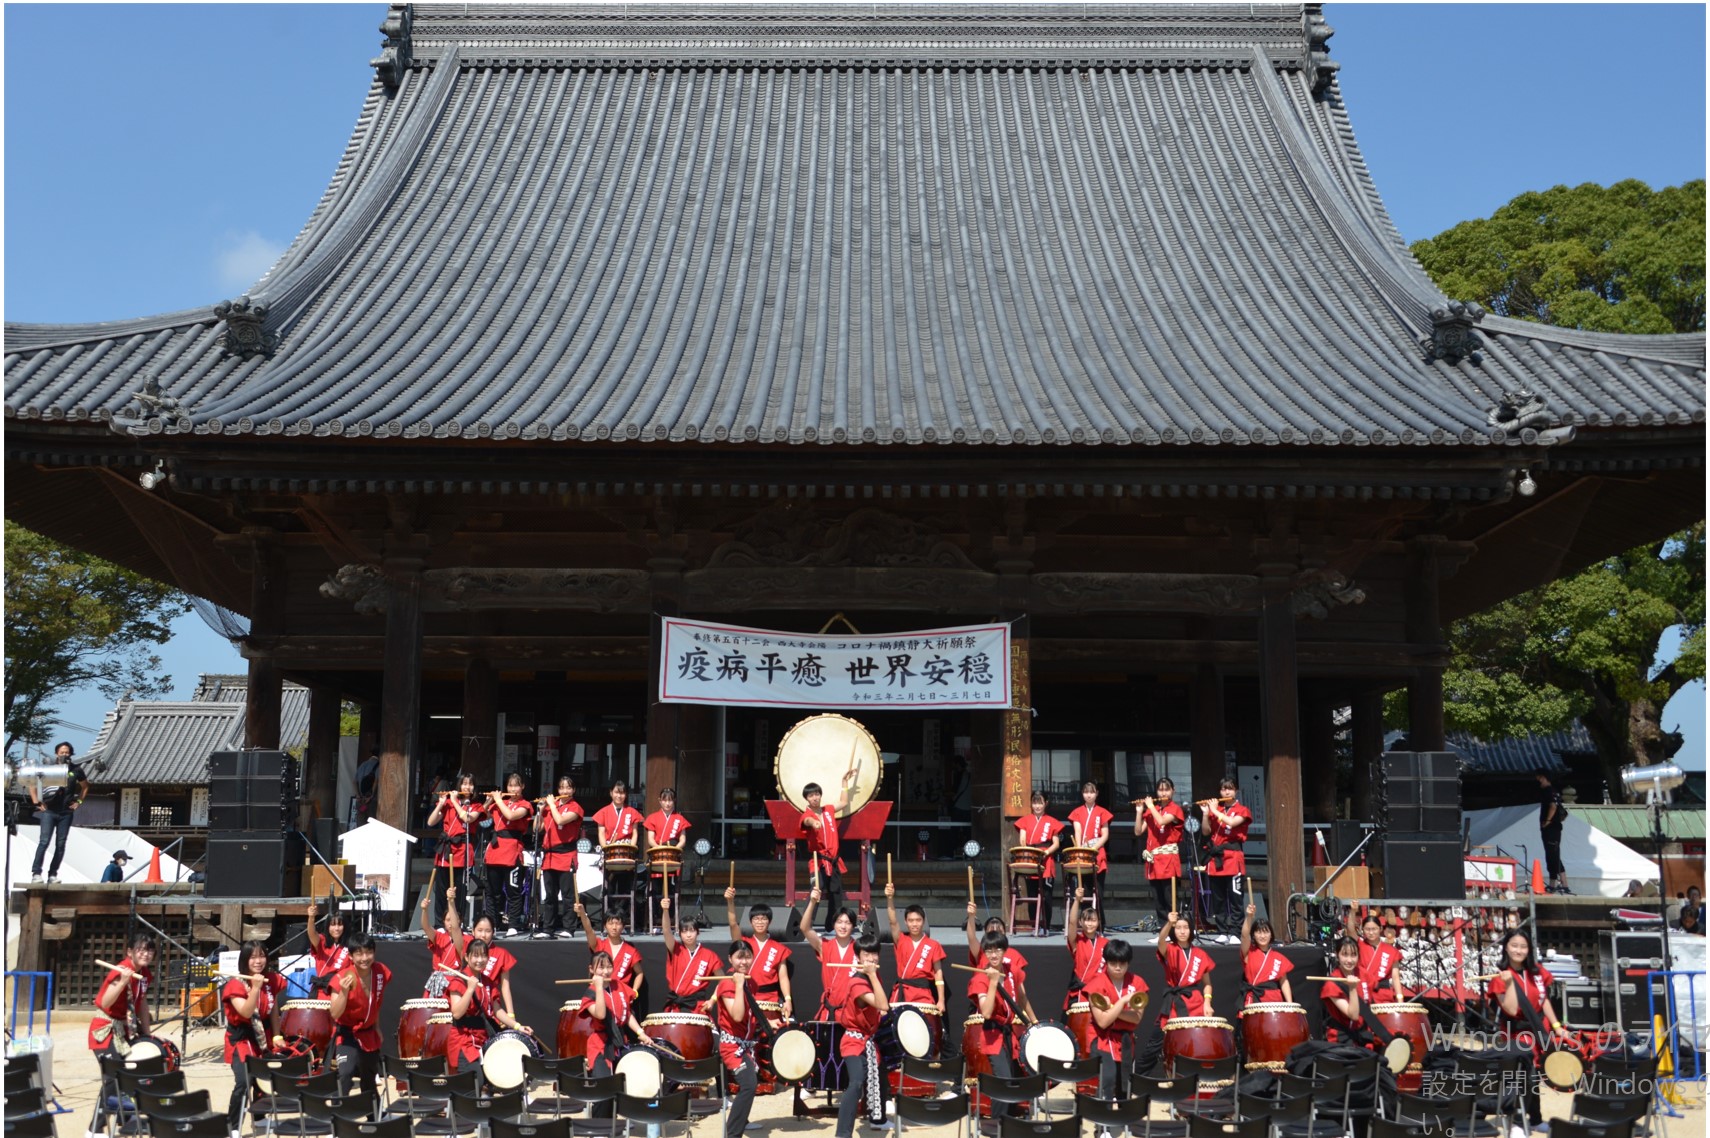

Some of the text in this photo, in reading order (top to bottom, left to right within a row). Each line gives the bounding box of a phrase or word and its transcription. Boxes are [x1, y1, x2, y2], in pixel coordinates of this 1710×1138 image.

[836, 635, 977, 651] コロナ禍鎮静大祈願祭
[677, 645, 994, 688] 疫病平癒 世界安穏
